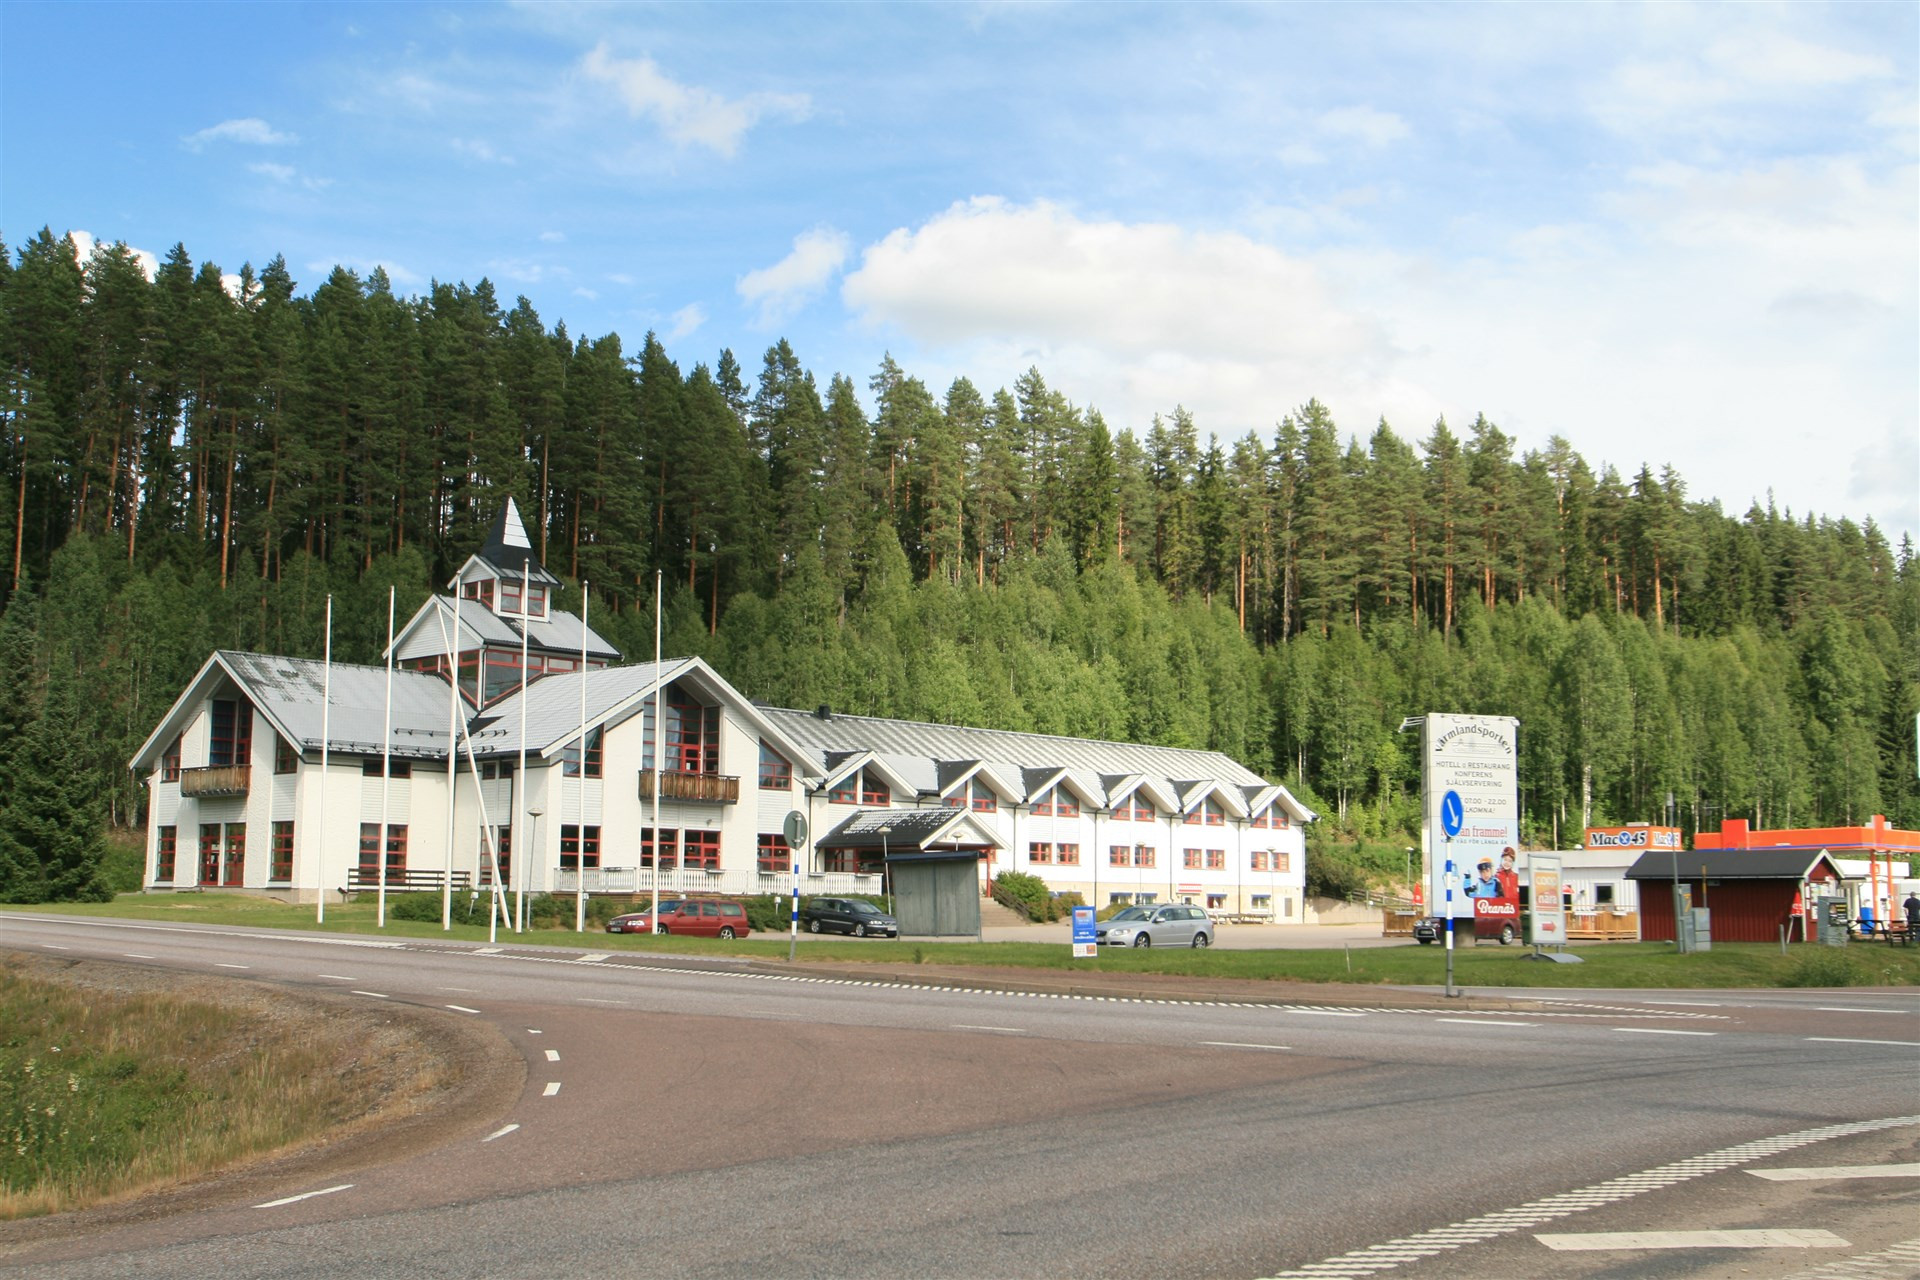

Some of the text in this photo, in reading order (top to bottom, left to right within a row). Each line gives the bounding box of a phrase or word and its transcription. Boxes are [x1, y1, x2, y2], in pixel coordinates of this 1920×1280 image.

[1435, 724, 1512, 754] Värmlandsporten
[1436, 761, 1461, 769] HOTELL
[1467, 762, 1511, 770] RESTAURANG
[1445, 779, 1503, 787] SJÄLVSERVERING
[1472, 825, 1508, 838] framme!
[1590, 832, 1647, 846] Mac 45
[1477, 899, 1516, 914] Branäs
